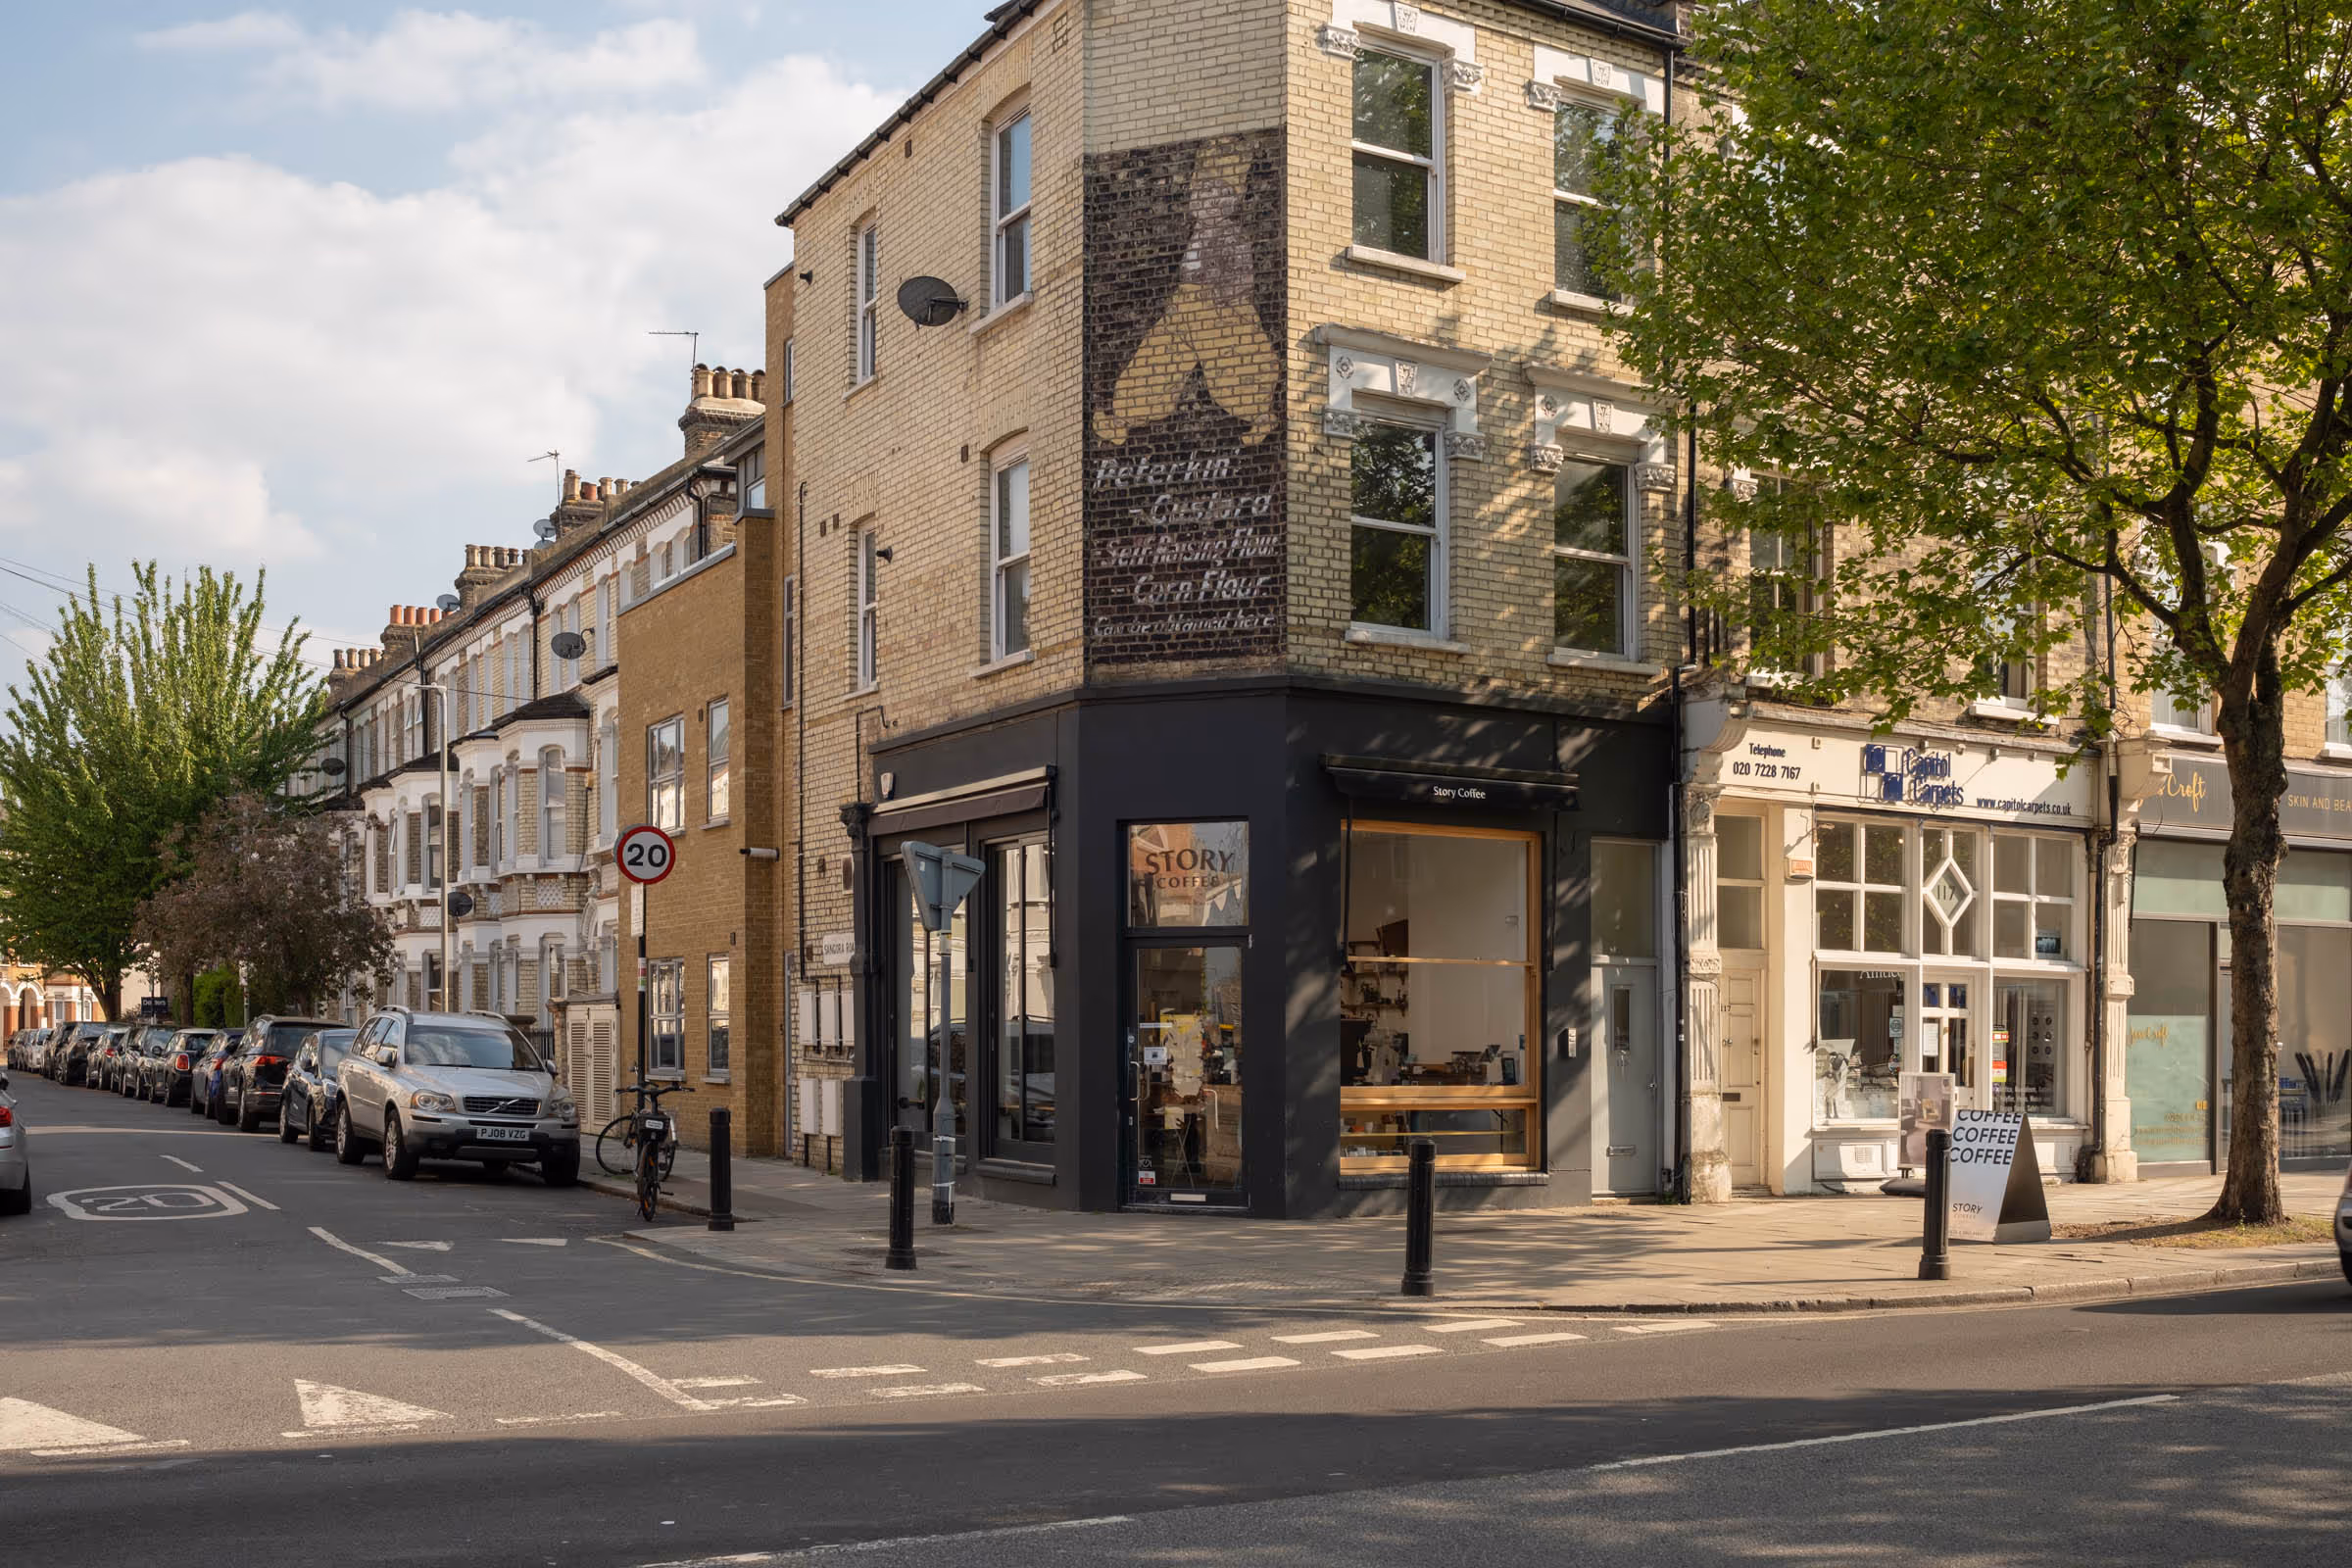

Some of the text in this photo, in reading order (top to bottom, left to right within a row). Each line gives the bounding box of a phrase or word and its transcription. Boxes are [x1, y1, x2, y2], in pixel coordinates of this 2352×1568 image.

[1134, 573, 1193, 604] Corn
[1748, 742, 1787, 759] Telephone
[1733, 761, 1801, 780] 020 7228 7167
[1906, 747, 1951, 782] Capitol
[1433, 785, 1487, 800] Story Coffee
[1913, 776, 1964, 810] Carpets
[2167, 771, 2207, 812] Croft
[1976, 797, 2072, 815] www.capitolcarpets.co.uk
[2288, 794, 2309, 808] SKIN
[2312, 796, 2330, 810] AND
[627, 843, 667, 868] 20
[1145, 848, 1235, 875] STORY
[1156, 875, 1219, 889] COFFEE
[1936, 885, 1956, 901] 117
[845, 941, 856, 954] ROA
[1957, 1109, 2023, 1124] COFFEE
[480, 1128, 526, 1139] PJ08 VZG
[1952, 1126, 2019, 1145] COFFEE
[1950, 1147, 2014, 1165] COFFEE
[80, 1192, 216, 1211] 20
[1952, 1202, 1984, 1214] STORY
